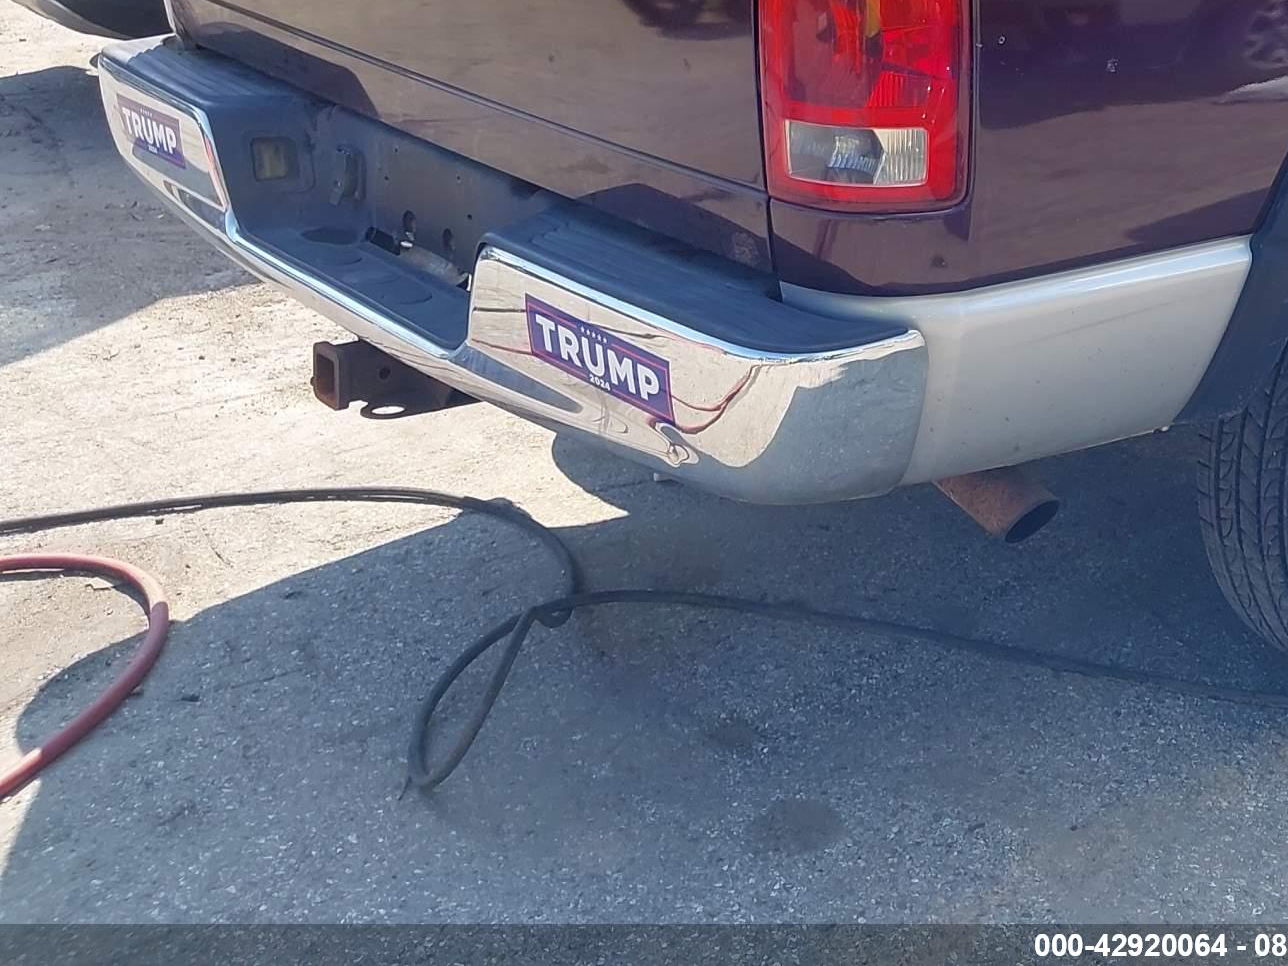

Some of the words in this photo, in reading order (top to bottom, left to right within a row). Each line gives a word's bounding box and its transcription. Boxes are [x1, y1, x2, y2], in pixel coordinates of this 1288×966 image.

[121, 107, 177, 154] TRUMP
[535, 313, 660, 401] TRUMP
[588, 374, 611, 392] 2024
